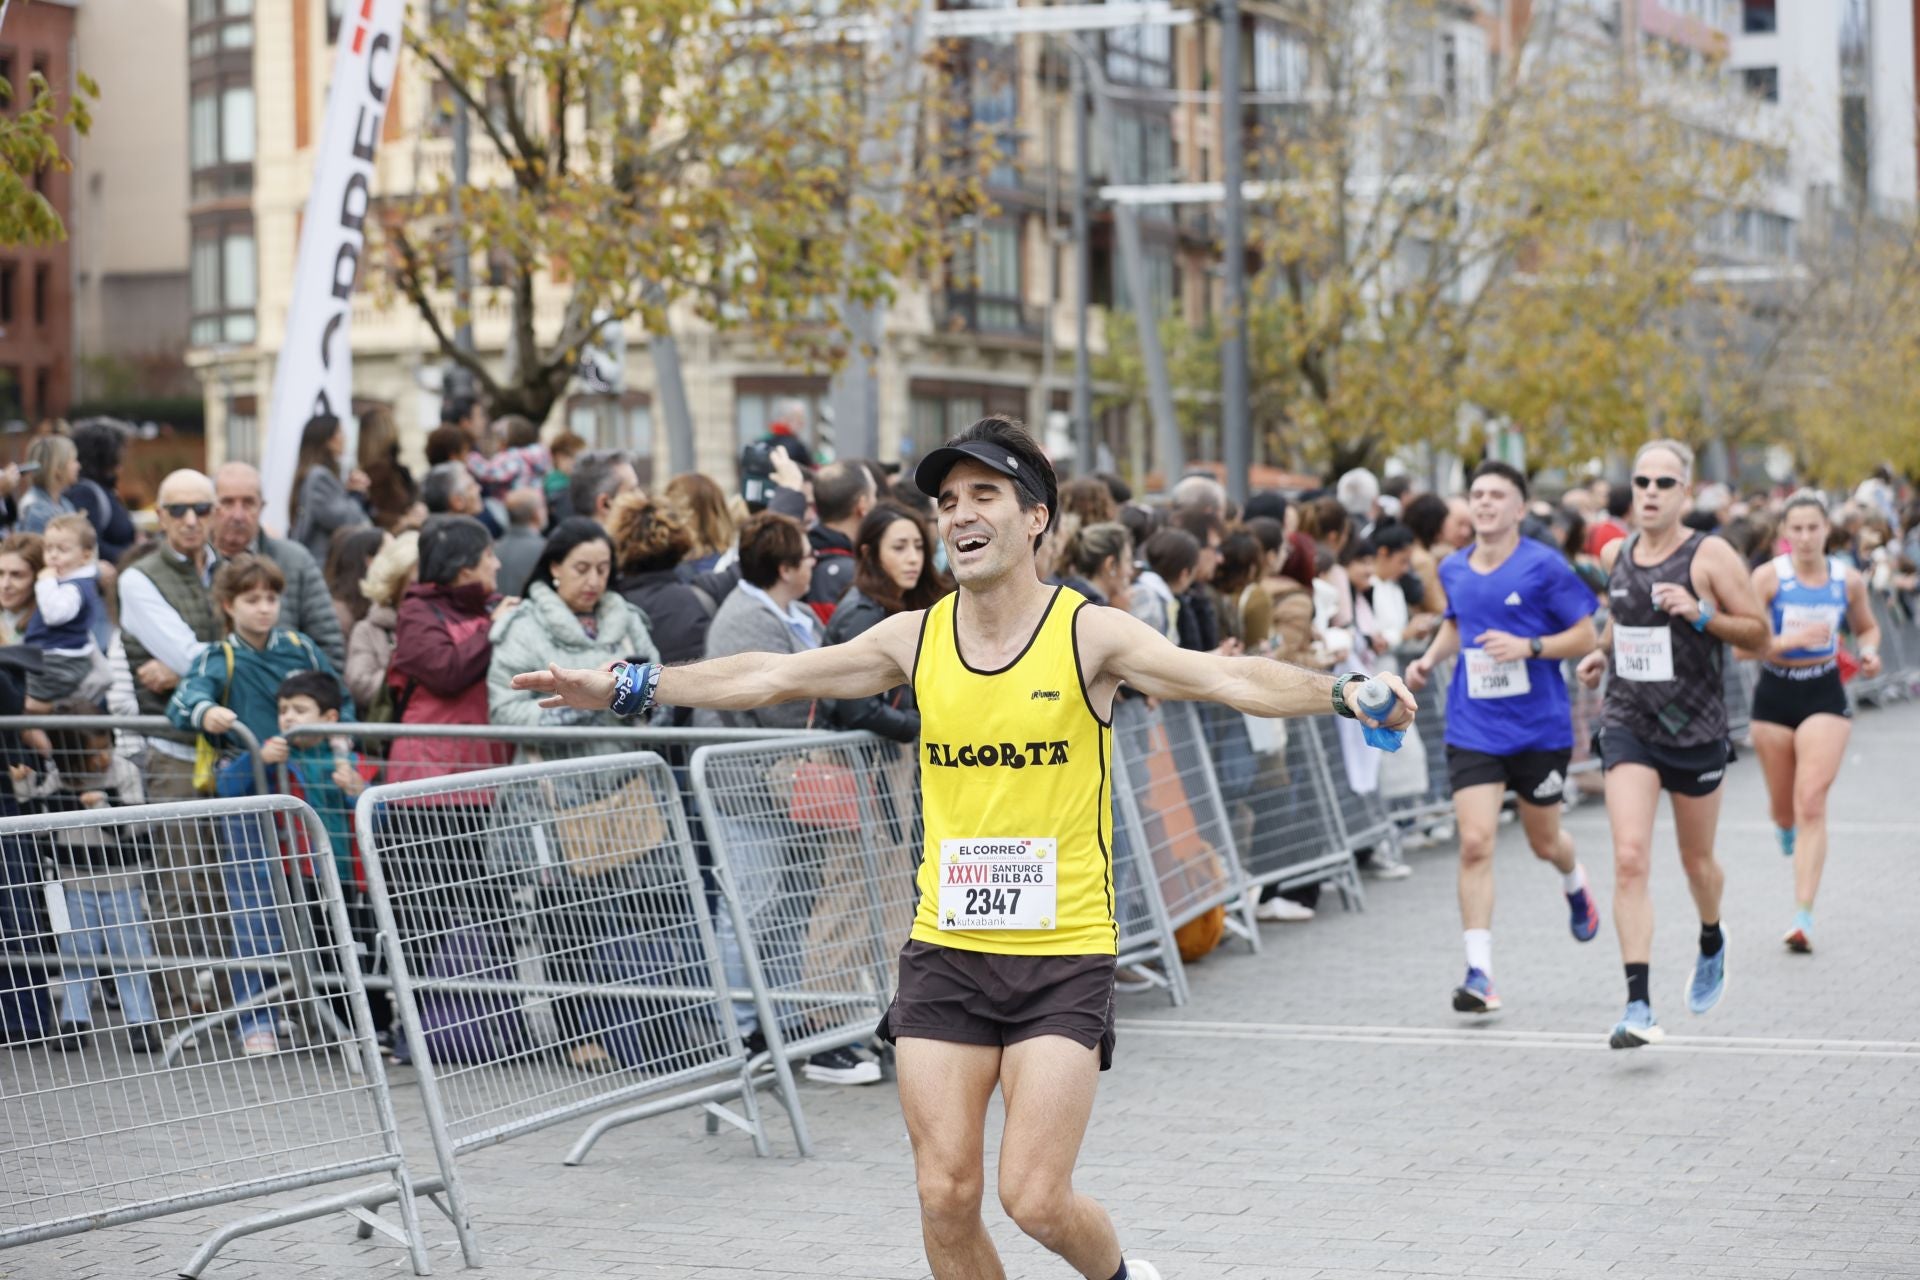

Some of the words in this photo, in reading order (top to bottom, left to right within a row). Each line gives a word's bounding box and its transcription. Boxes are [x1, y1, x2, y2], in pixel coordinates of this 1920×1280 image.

[926, 740, 1069, 769] ALGORTA
[960, 846, 971, 855] EL
[974, 845, 1026, 855] CORREO
[992, 864, 1043, 873] SANTURCE
[947, 864, 988, 884] XXXVI
[992, 873, 1043, 883] BILBAO
[965, 888, 1022, 915] 2347
[957, 917, 1006, 926] kutxabank
